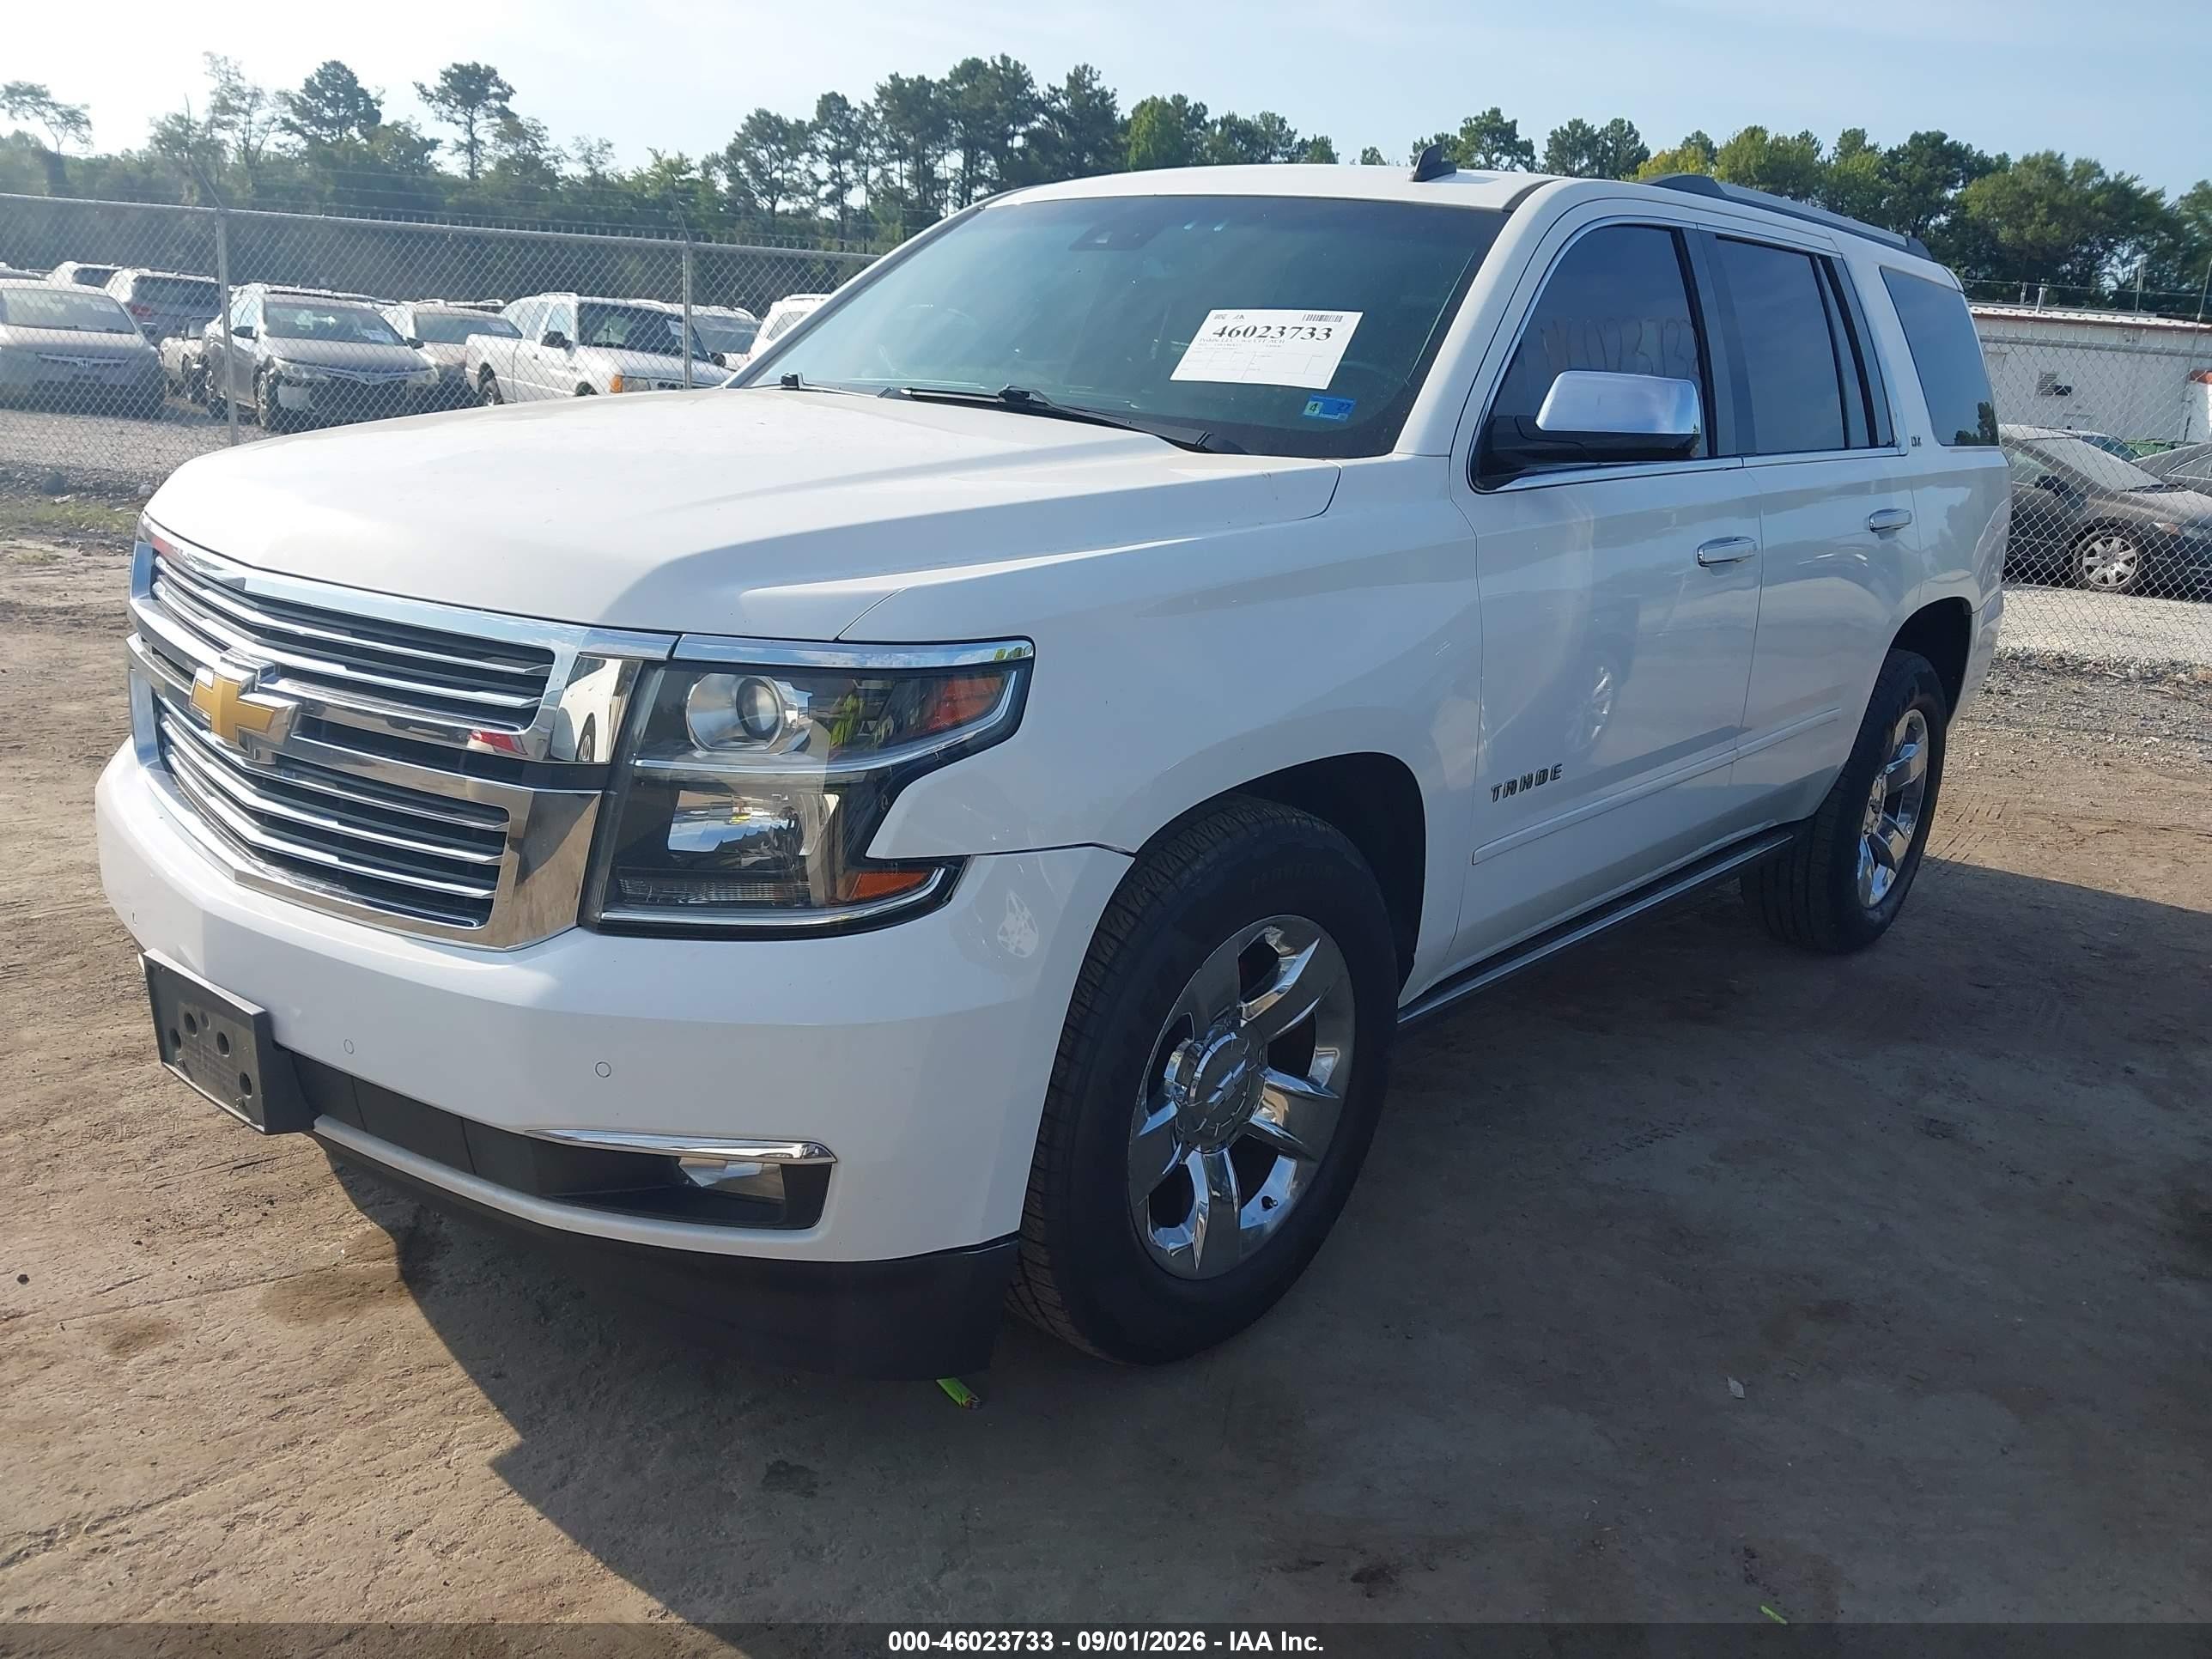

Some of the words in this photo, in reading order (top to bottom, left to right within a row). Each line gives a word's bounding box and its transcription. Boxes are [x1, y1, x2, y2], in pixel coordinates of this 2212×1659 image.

[1212, 325, 1333, 341] 46023733
[1310, 403, 1319, 412] 4
[1491, 763, 1563, 803] TAHOE
